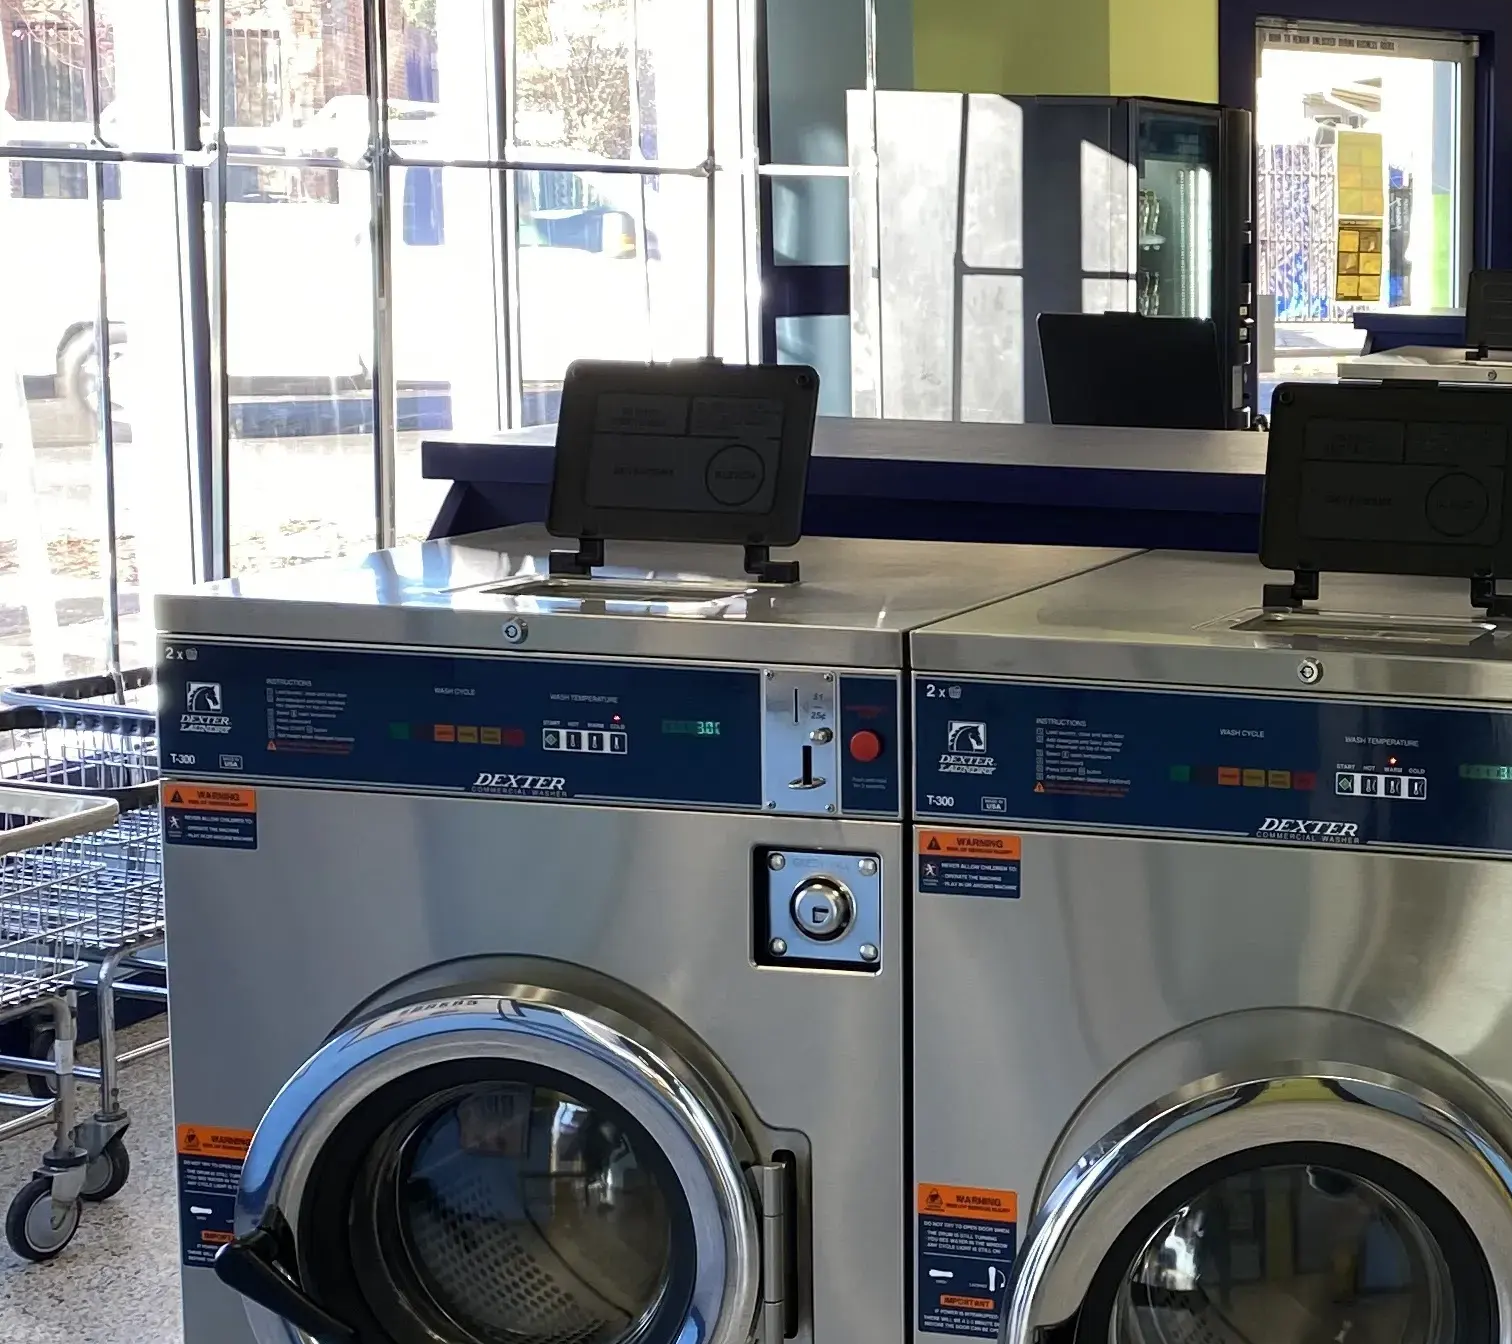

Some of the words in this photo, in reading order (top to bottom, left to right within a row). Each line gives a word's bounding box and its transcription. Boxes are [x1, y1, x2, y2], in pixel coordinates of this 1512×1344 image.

[165, 646, 174, 659] 2
[926, 684, 936, 697] 2
[938, 688, 946, 698] x
[180, 715, 230, 725] DEXTER
[1036, 718, 1087, 727] INSTRUCTIONS
[1219, 728, 1241, 737] WASH
[1242, 729, 1265, 738] CYCLE
[1345, 736, 1366, 744] WASH
[1367, 737, 1420, 748] TEMPERATURE
[170, 753, 196, 764] T-300
[939, 754, 994, 766] DEXTER
[473, 773, 566, 790] DEXTER
[532, 789, 568, 798] WASHER
[926, 795, 955, 807] T-300
[1258, 817, 1359, 837] DEXTER
[957, 838, 1003, 848] WARNING
[1256, 831, 1316, 842] COMMERCIAL
[1322, 835, 1360, 844] WASHER
[956, 1195, 1001, 1206] WARNING
[944, 1297, 990, 1307] IMPORTANT
